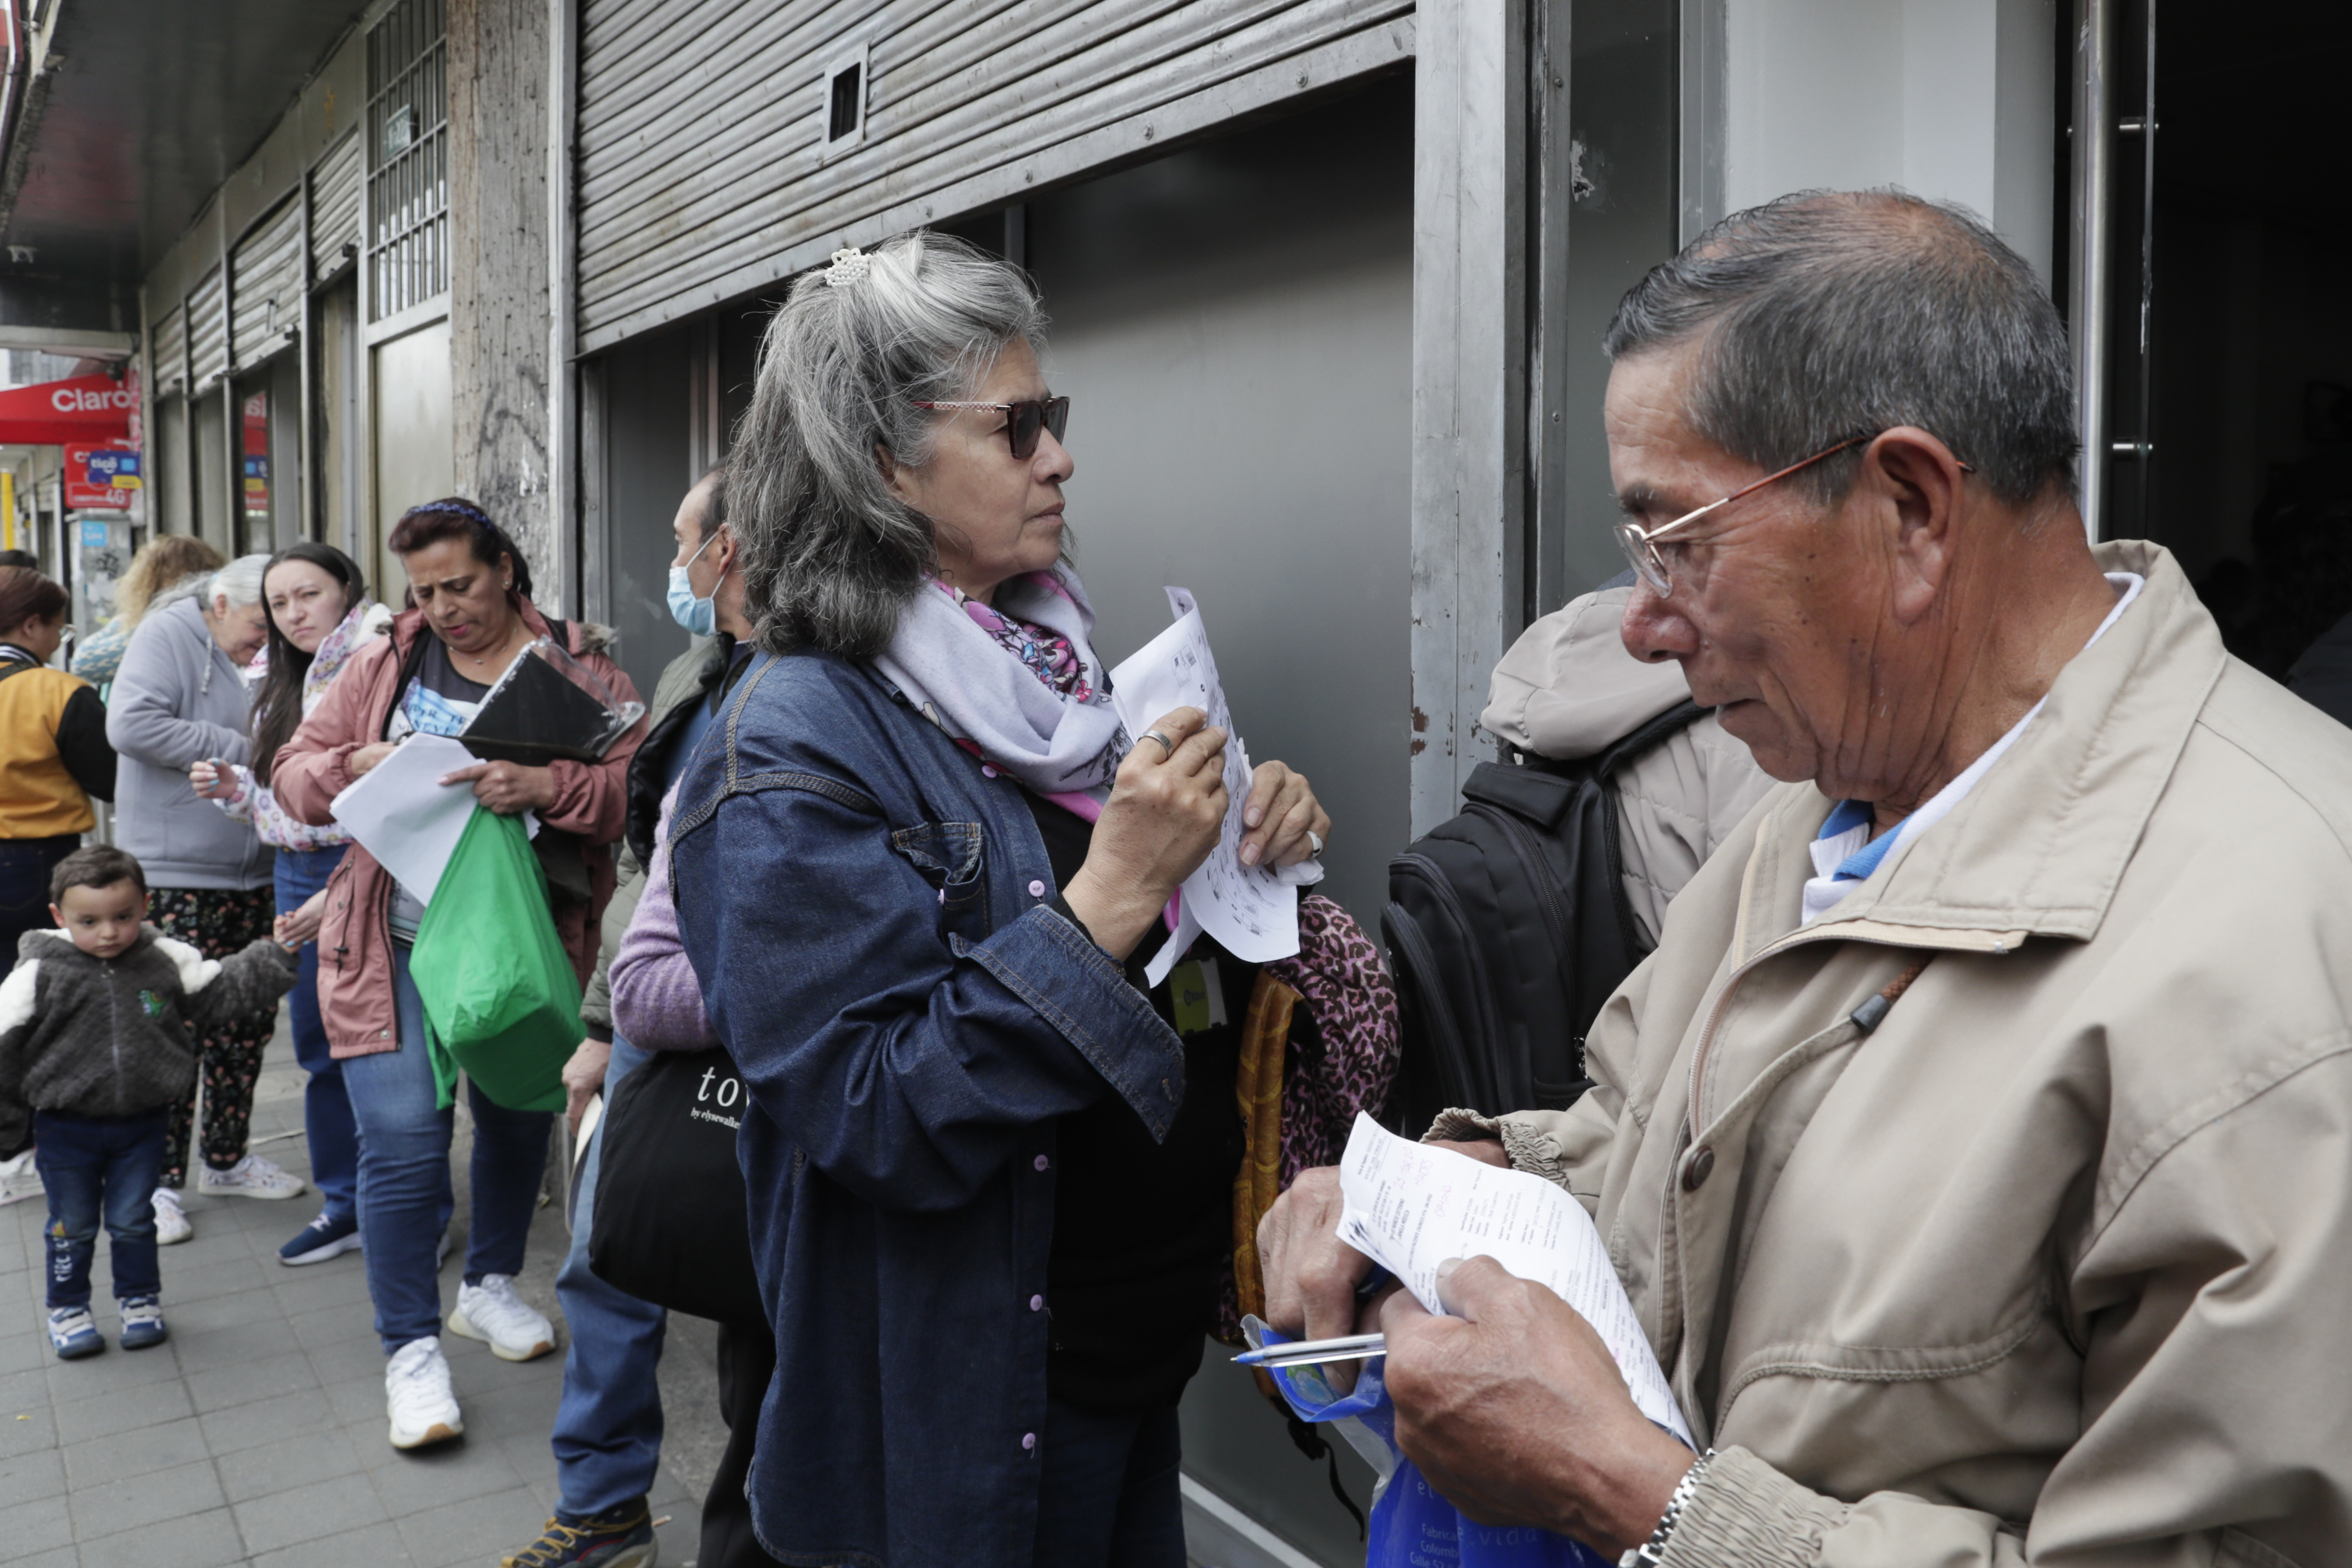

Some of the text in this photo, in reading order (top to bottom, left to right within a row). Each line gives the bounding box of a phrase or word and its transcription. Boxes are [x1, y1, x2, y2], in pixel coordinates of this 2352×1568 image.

[51, 388, 131, 412] Claro
[691, 1107, 701, 1119] by
[1415, 1159, 1433, 1187] MARTES
[1410, 1551, 1431, 1568] Calle
